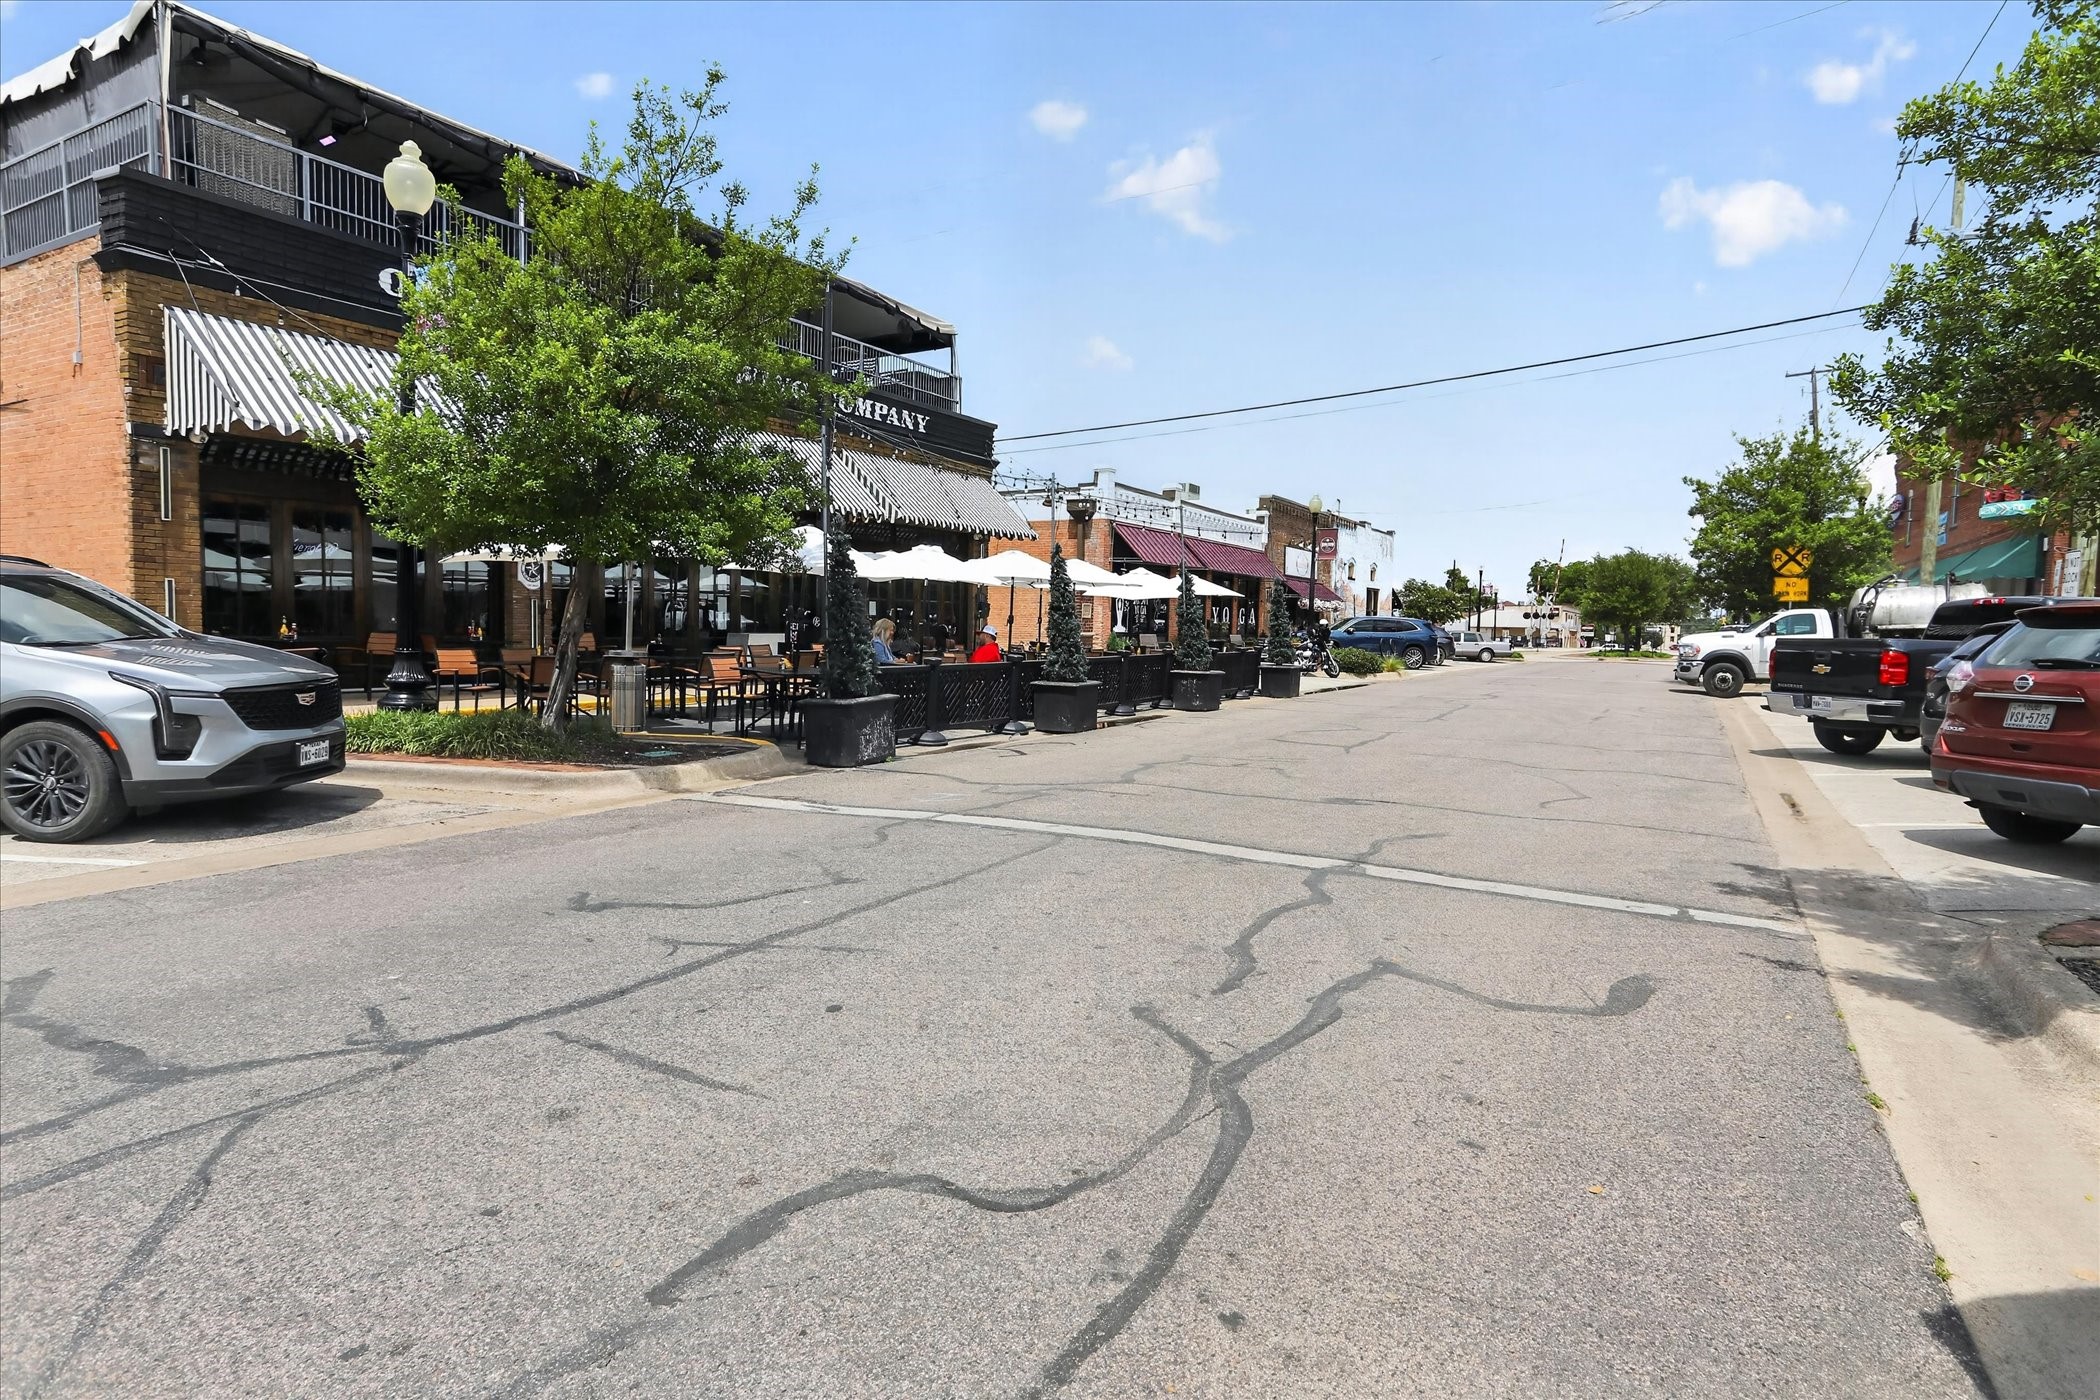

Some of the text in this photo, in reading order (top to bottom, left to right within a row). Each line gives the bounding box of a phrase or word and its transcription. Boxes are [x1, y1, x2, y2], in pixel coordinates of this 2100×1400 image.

[833, 393, 930, 433] OMPANY
[1774, 552, 1810, 563] R R
[1212, 606, 1256, 625] YOGA
[2009, 711, 2051, 725] VSX-5725
